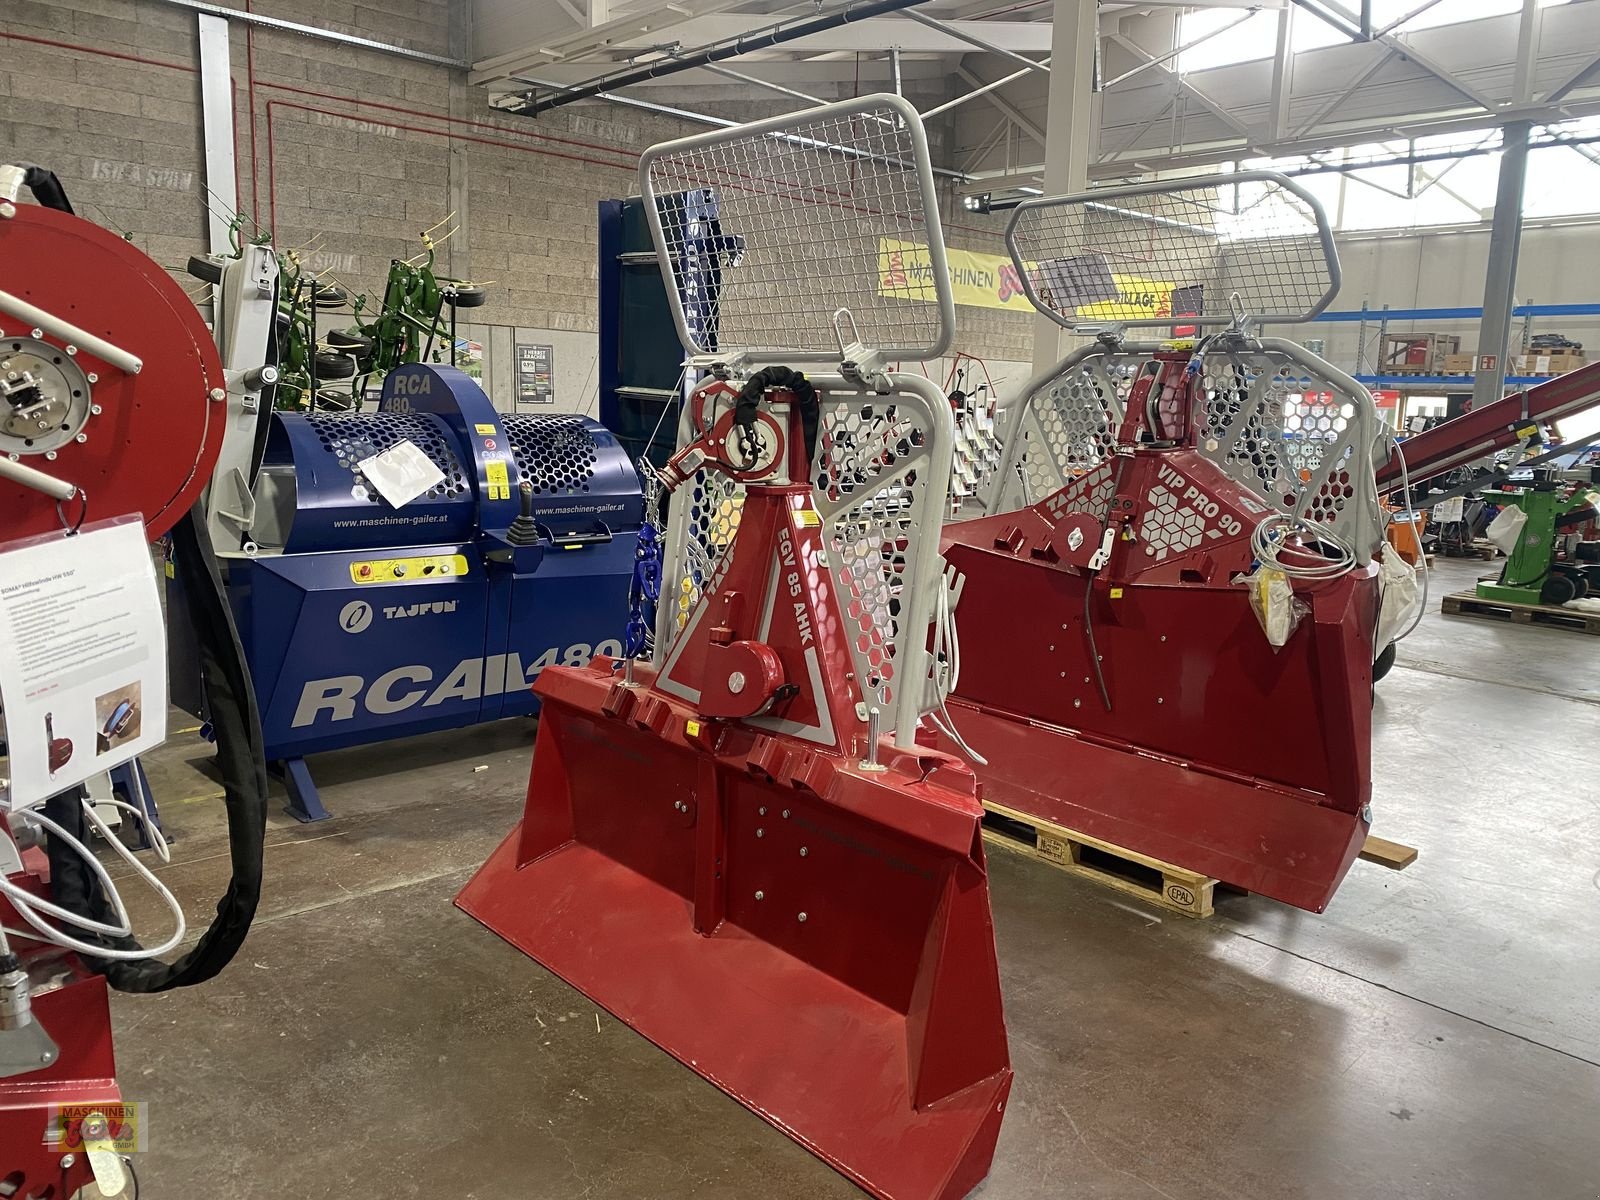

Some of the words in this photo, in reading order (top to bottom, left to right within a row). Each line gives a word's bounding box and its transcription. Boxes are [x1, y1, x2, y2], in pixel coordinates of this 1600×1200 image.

[909, 262, 994, 289] MAHINEN
[393, 374, 431, 395] RCA
[384, 397, 410, 414] 480
[533, 503, 625, 516] www.maschinen-gailer.at
[1157, 463, 1186, 489] VIP
[1182, 485, 1220, 518] PRO
[1218, 514, 1242, 536] 90
[333, 514, 449, 528] www.maschinen-gailer.at
[777, 527, 796, 567] EGV
[787, 572, 802, 598] 85
[382, 600, 457, 619] TAJFUN
[793, 602, 814, 646] AHK
[1171, 887, 1191, 904] EPAL
